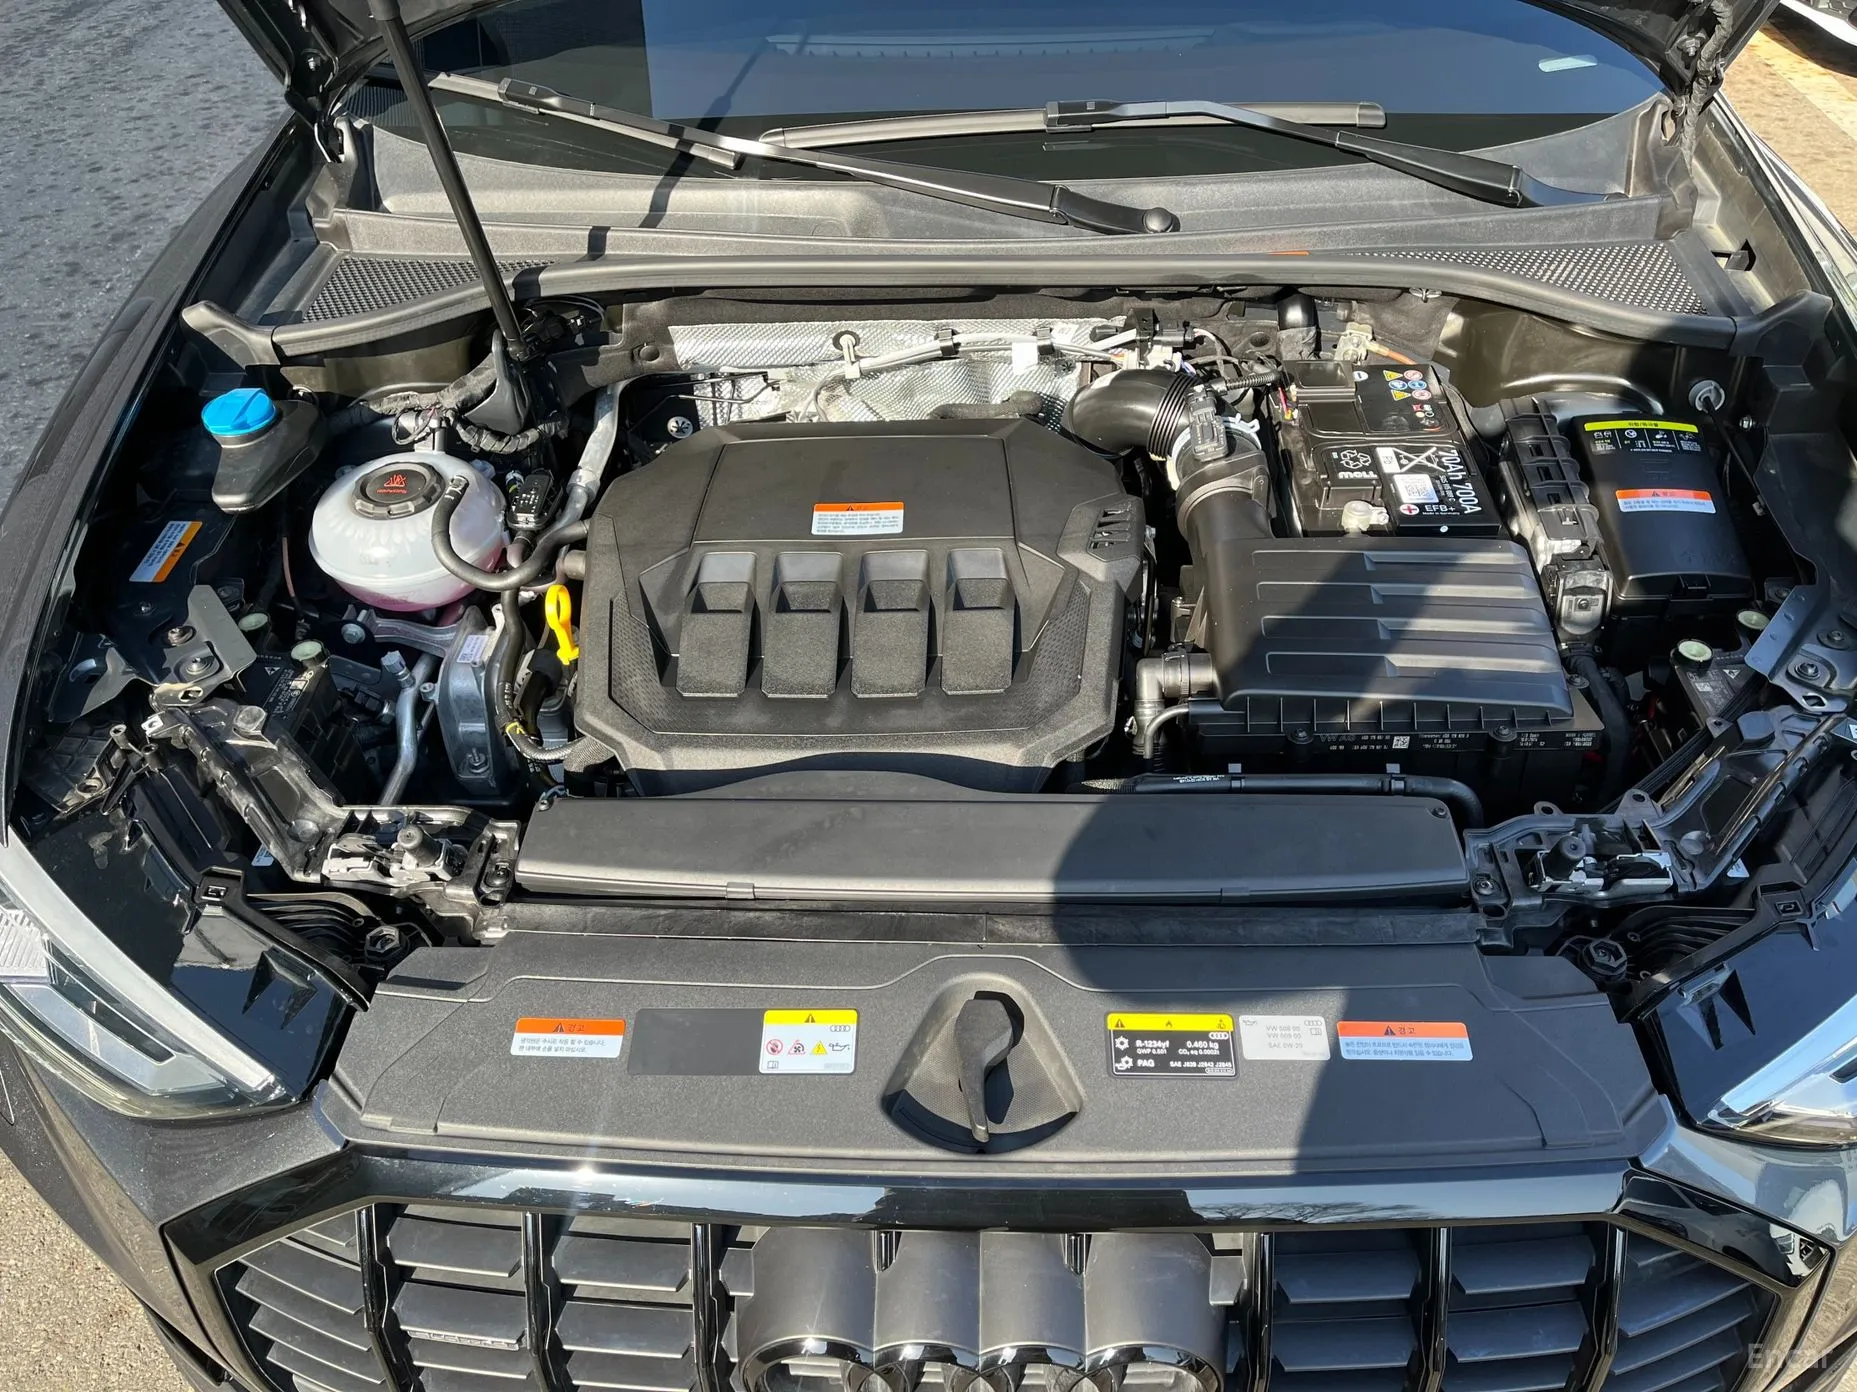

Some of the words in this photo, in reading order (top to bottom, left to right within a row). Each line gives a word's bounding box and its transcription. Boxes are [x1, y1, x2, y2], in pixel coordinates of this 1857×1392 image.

[1438, 449, 1467, 480] 70Ah
[1453, 482, 1482, 514] 700A
[1424, 504, 1456, 512] EFB+
[1135, 1040, 1170, 1049] R-1234yf
[1209, 1040, 1219, 1050] kg
[1136, 1059, 1155, 1068] PAG
